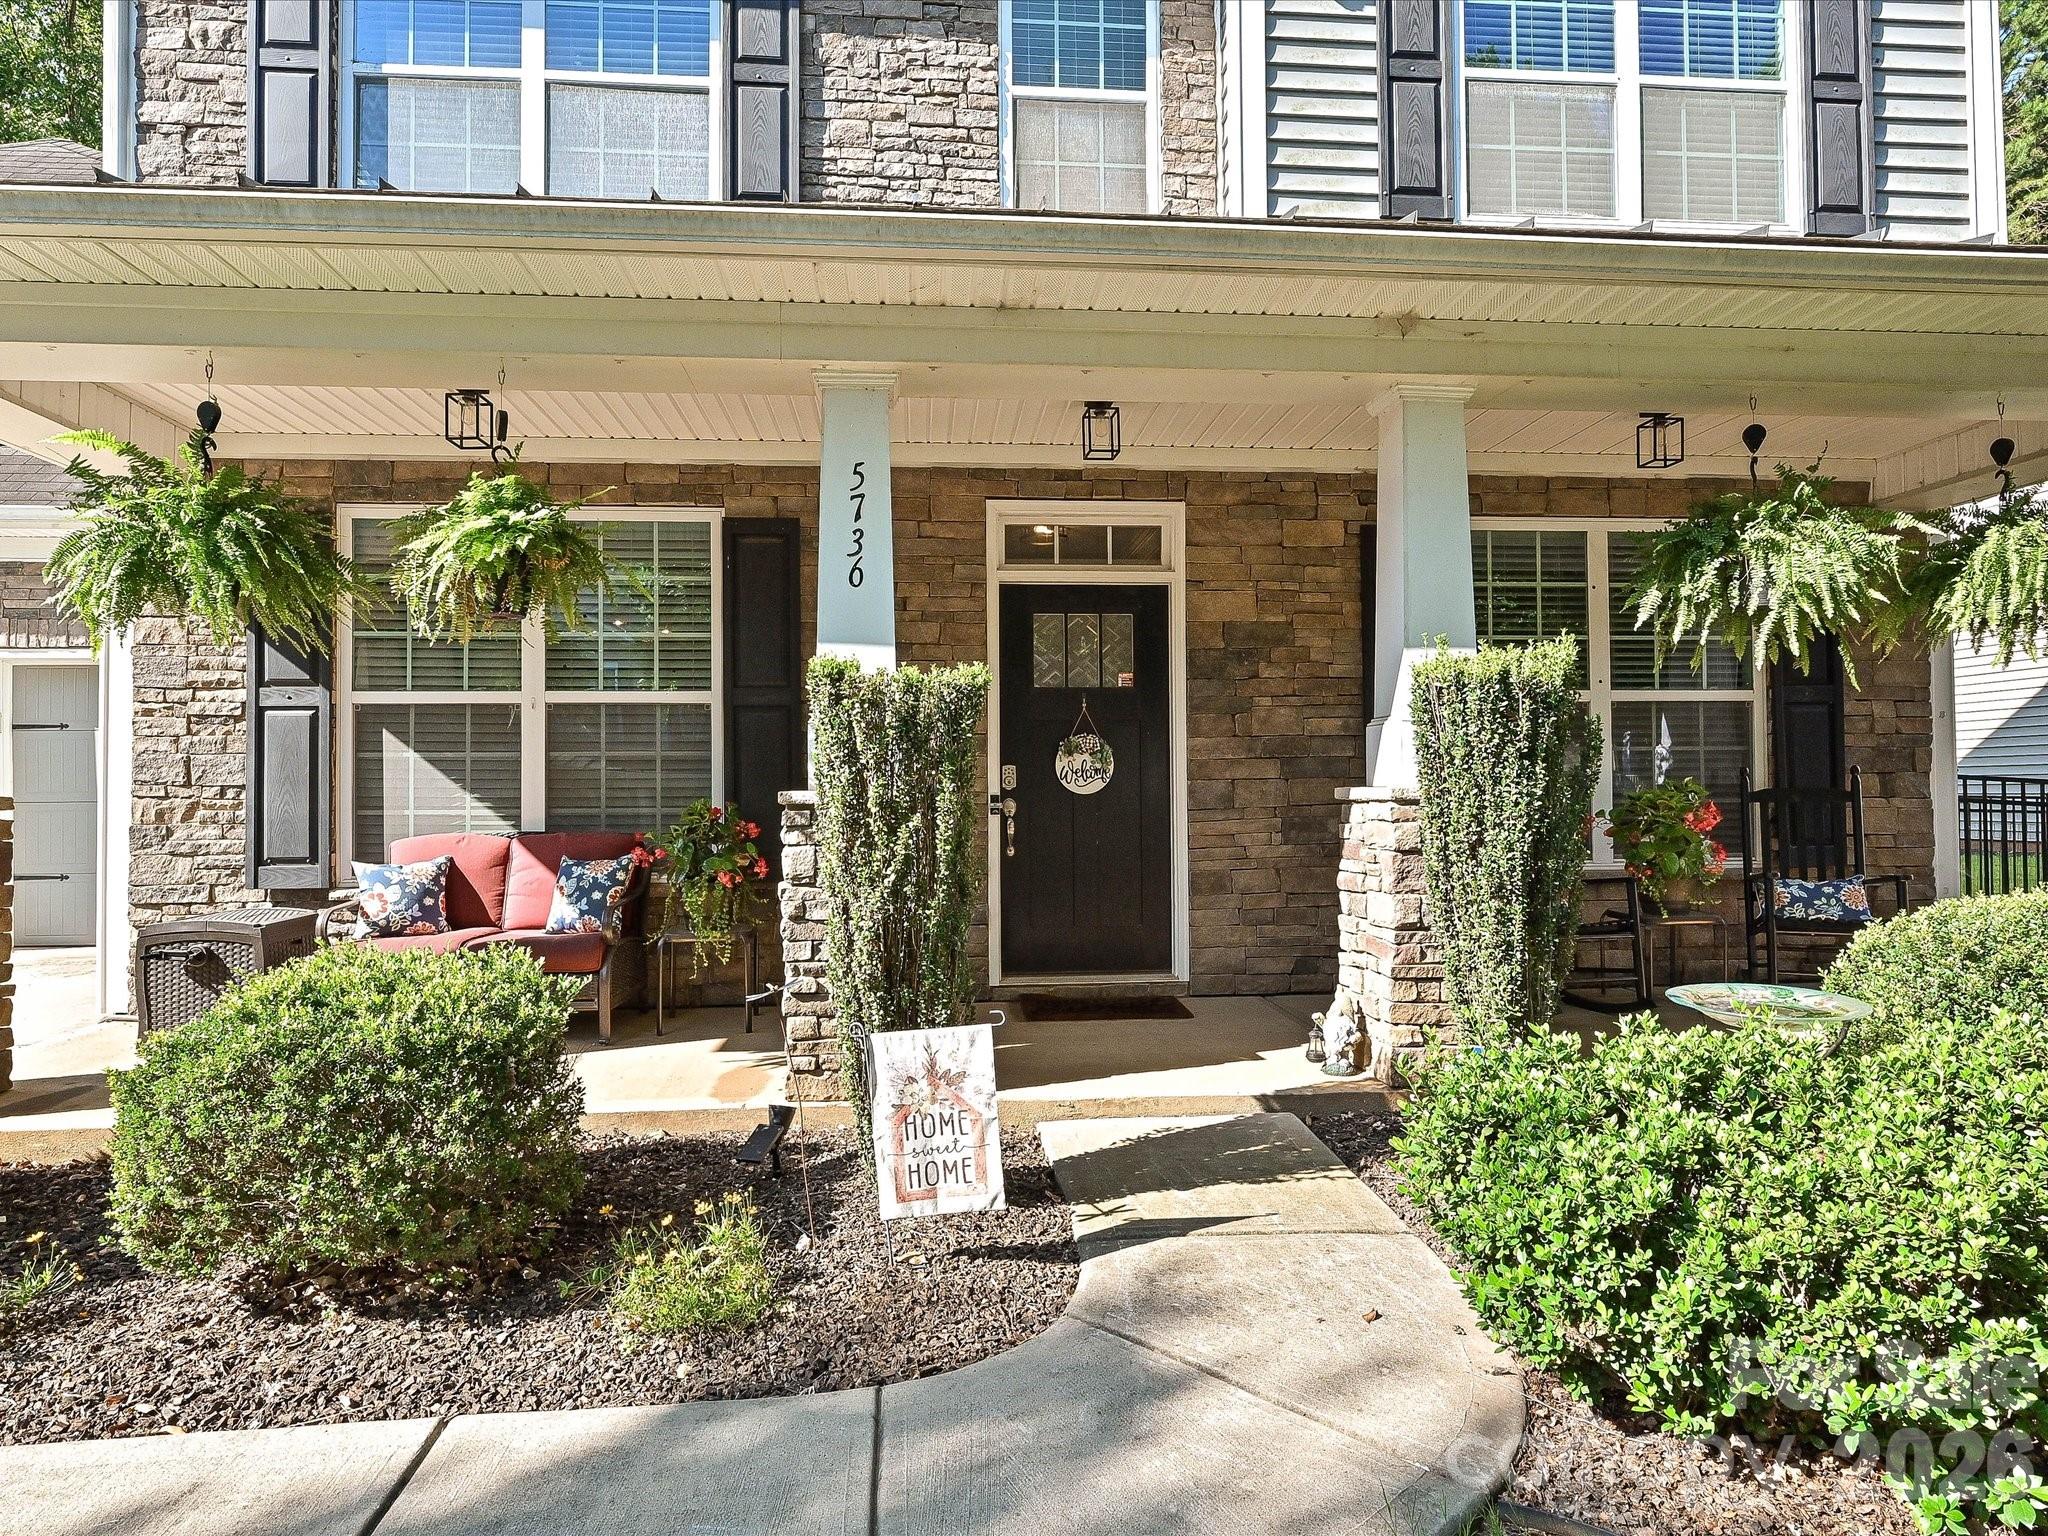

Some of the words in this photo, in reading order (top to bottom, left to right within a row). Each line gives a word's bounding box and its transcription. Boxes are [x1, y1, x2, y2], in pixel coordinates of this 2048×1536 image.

[847, 461, 866, 588] 5736
[1060, 759, 1111, 788] Welcome
[904, 1109, 969, 1142] HOME
[887, 1137, 990, 1159] sweet
[908, 1157, 973, 1190] HOME
